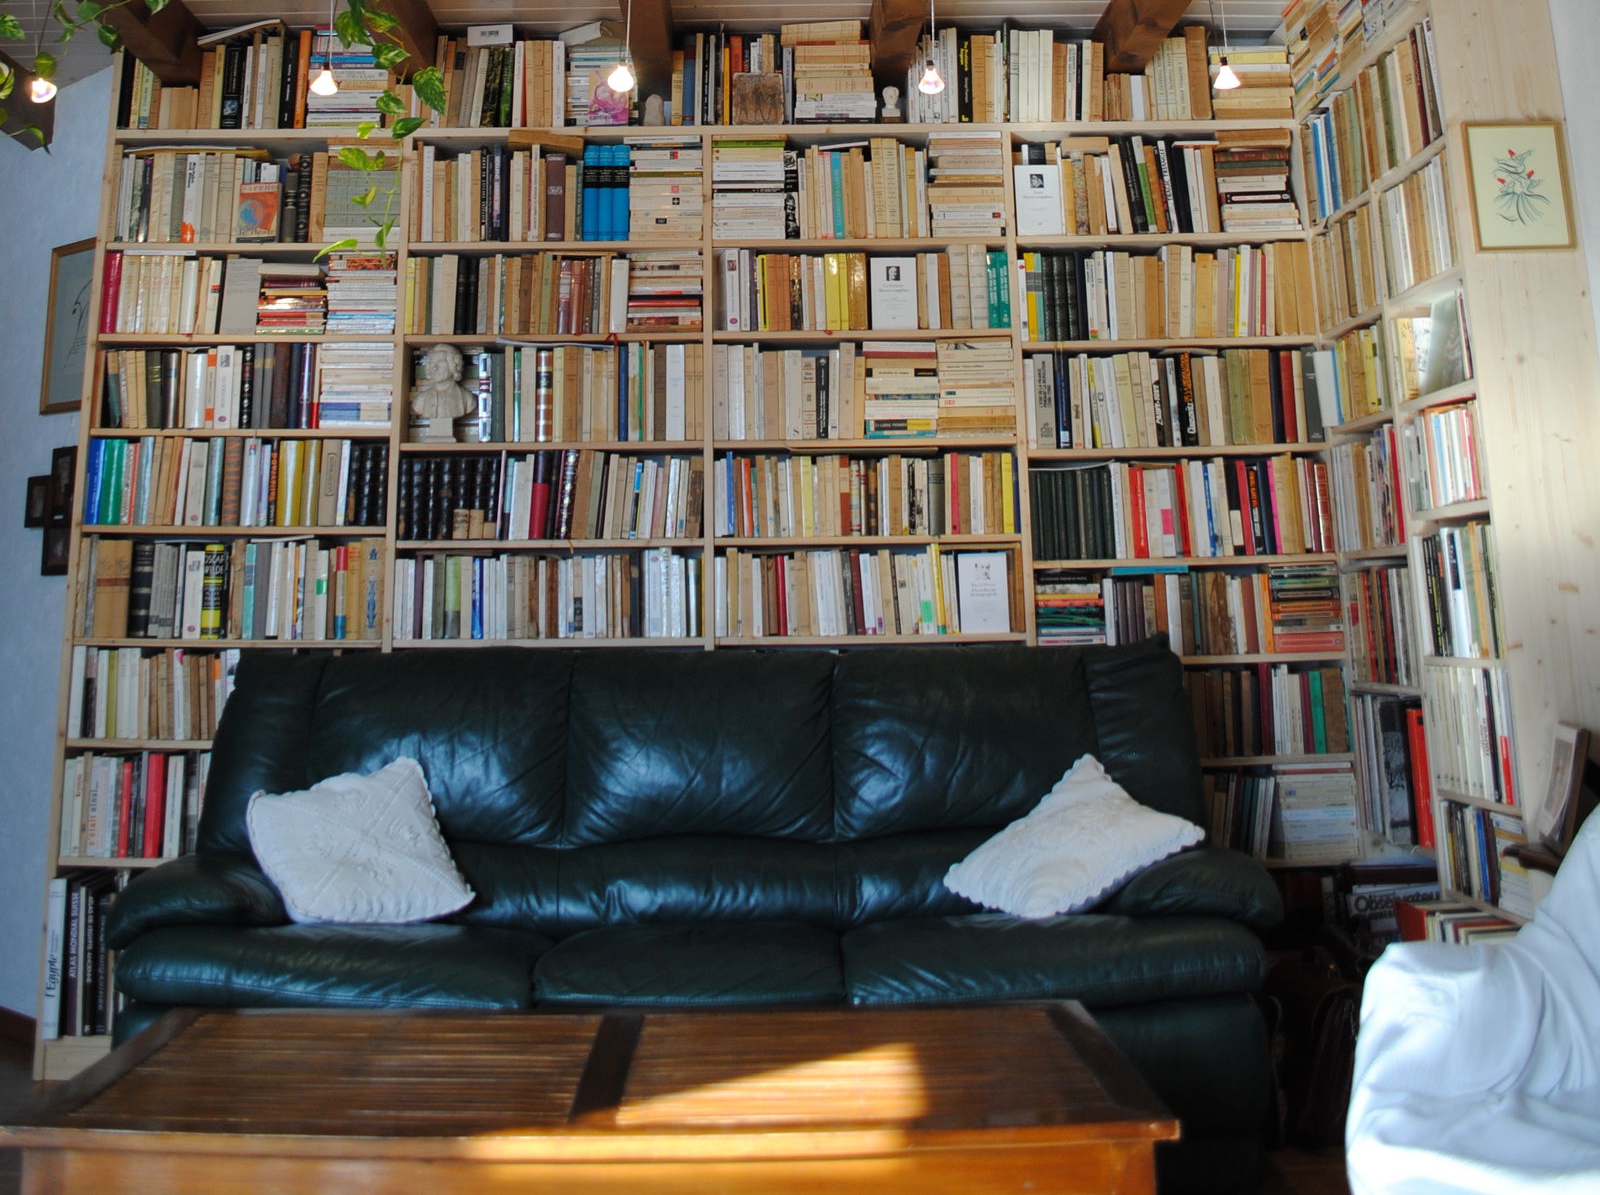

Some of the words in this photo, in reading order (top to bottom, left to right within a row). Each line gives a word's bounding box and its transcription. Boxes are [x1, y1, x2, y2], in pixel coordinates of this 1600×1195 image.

[1159, 148, 1169, 177] TRIANGLE
[70, 891, 80, 917] SUISSE
[69, 919, 79, 955] MONDIAL
[68, 955, 77, 978] ATLAS
